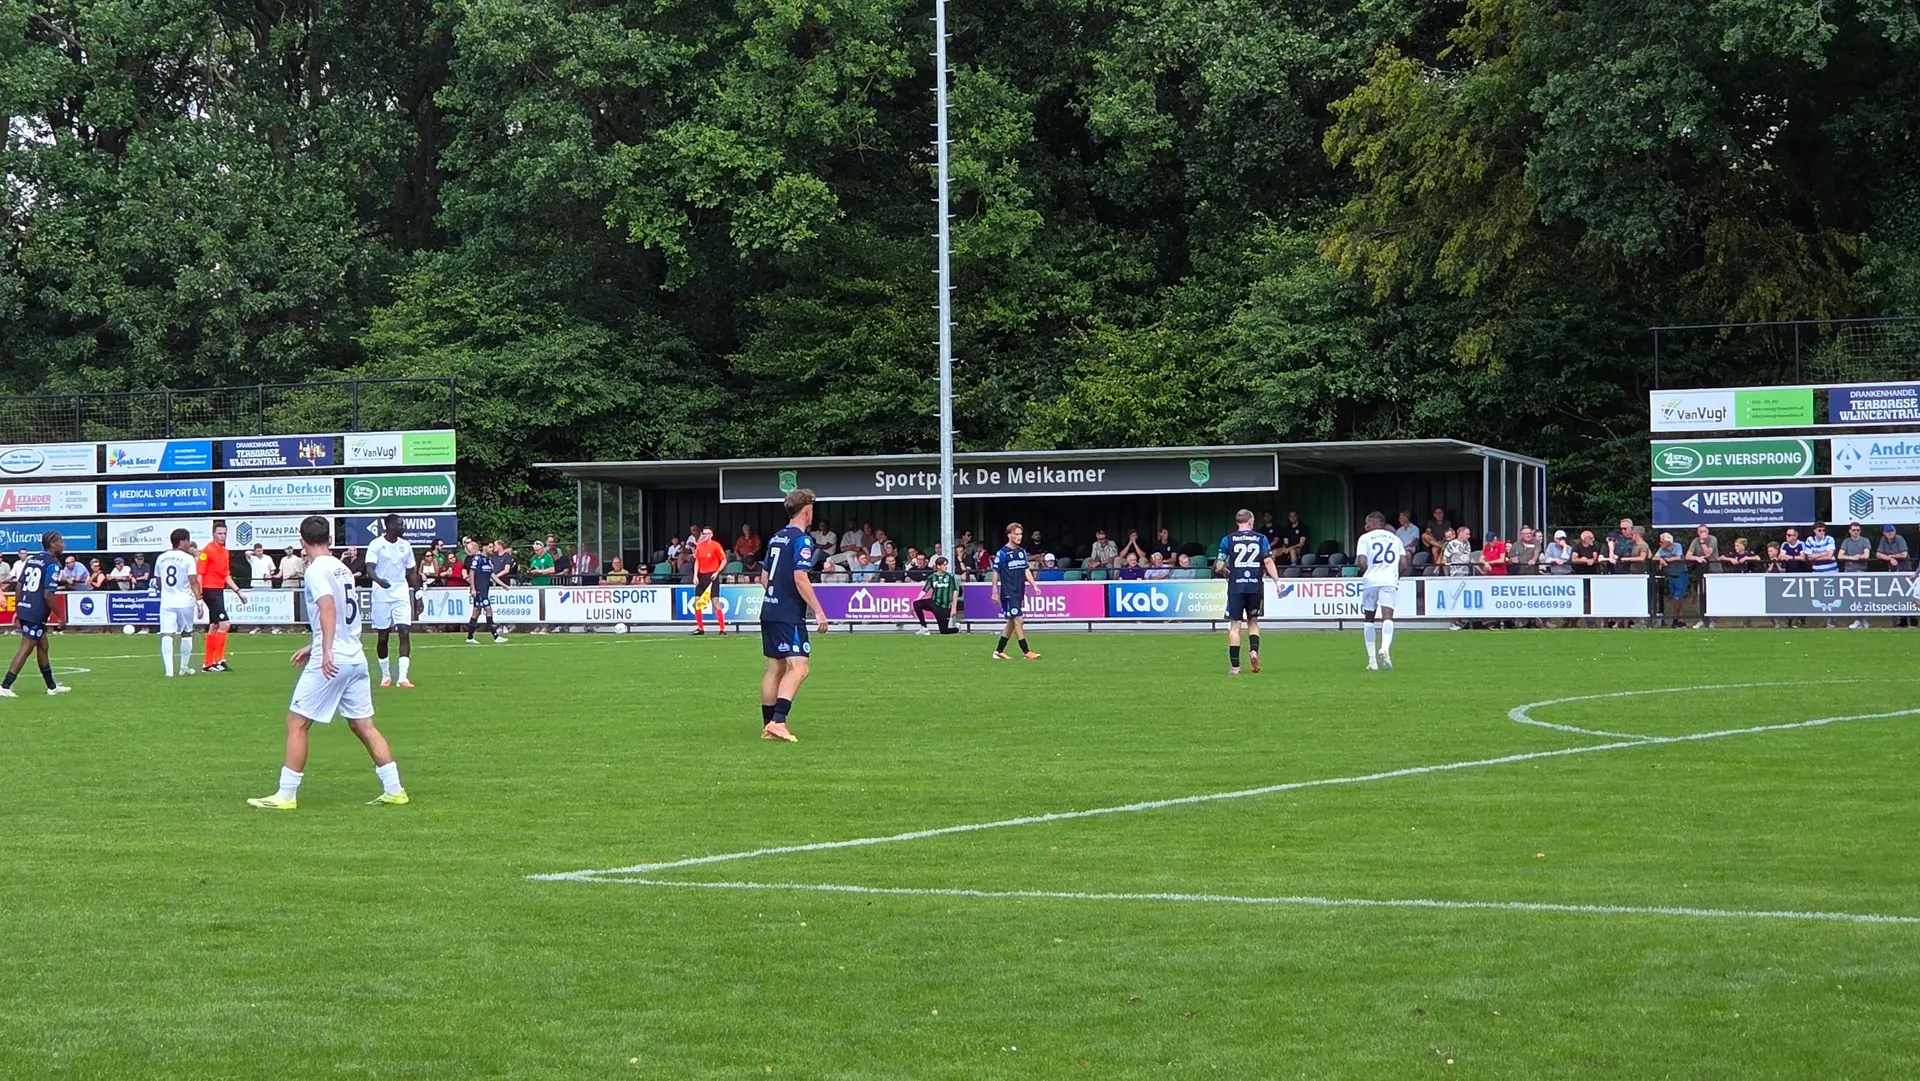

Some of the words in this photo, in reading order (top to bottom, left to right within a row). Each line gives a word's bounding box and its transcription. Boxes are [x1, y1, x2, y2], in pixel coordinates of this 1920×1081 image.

[1850, 388, 1918, 399] DRANKENHANDEL
[1849, 398, 1918, 411] TERBORGSE
[1706, 454, 1722, 466] DE
[1723, 452, 1802, 465] VIERSPRONG
[976, 470, 1001, 484] De
[1008, 466, 1106, 484] Meikamer
[120, 489, 153, 499] MEDICAL
[155, 488, 192, 498] SUPPORT
[193, 487, 208, 497] B.V.
[287, 482, 332, 494] Derksen
[382, 486, 394, 497] DE
[394, 485, 448, 496] VIERSPRONG
[1703, 491, 1783, 506] VIERWIND
[1877, 495, 1920, 506] TWAN
[255, 527, 282, 535] TWAN
[1233, 543, 1260, 568] 22
[1372, 542, 1396, 565] 26
[769, 547, 781, 580] 7
[22, 566, 42, 592] 38
[166, 565, 177, 587] 8
[1297, 583, 1364, 598] INTERSP
[1491, 585, 1576, 597] BEVEILIGING
[1781, 578, 1819, 598] ZIT
[1824, 578, 1835, 597] EN
[1839, 577, 1917, 597] RELAX
[572, 590, 657, 604] INTERSPORT
[1116, 587, 1169, 612] kab
[235, 604, 270, 614] Gieling
[344, 584, 357, 625] 5
[1495, 600, 1572, 609] 0800-6666999
[1850, 602, 1862, 612] dé
[586, 608, 632, 620] LUISING
